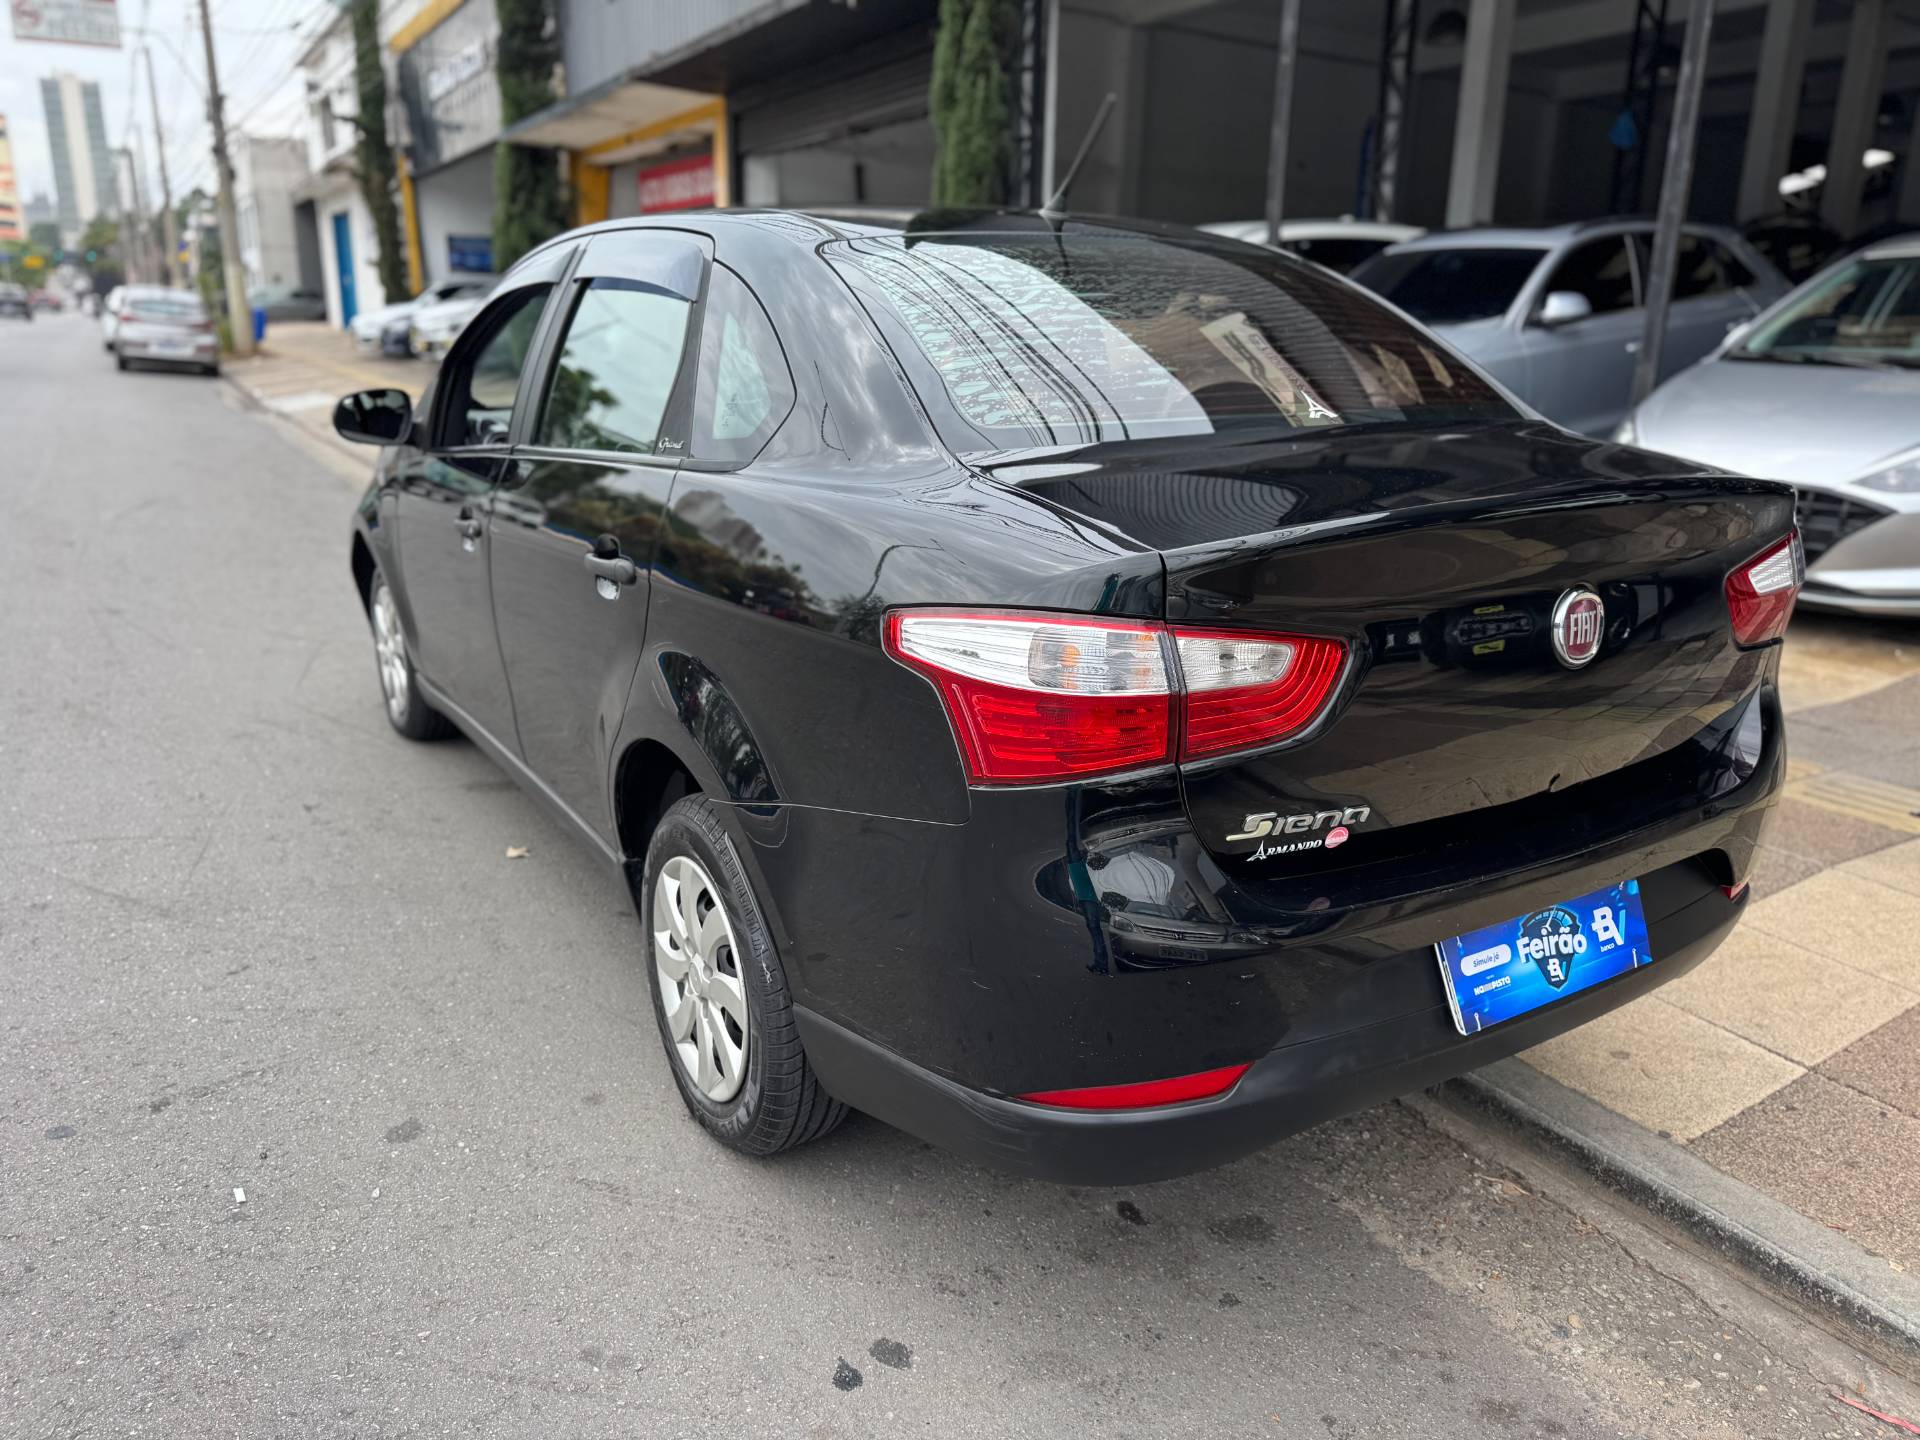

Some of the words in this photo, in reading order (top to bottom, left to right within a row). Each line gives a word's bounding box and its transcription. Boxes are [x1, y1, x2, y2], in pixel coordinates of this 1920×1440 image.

[1569, 610, 1597, 646] FIAT
[1226, 804, 1371, 841] Siena
[1516, 926, 1587, 964] Feirão
